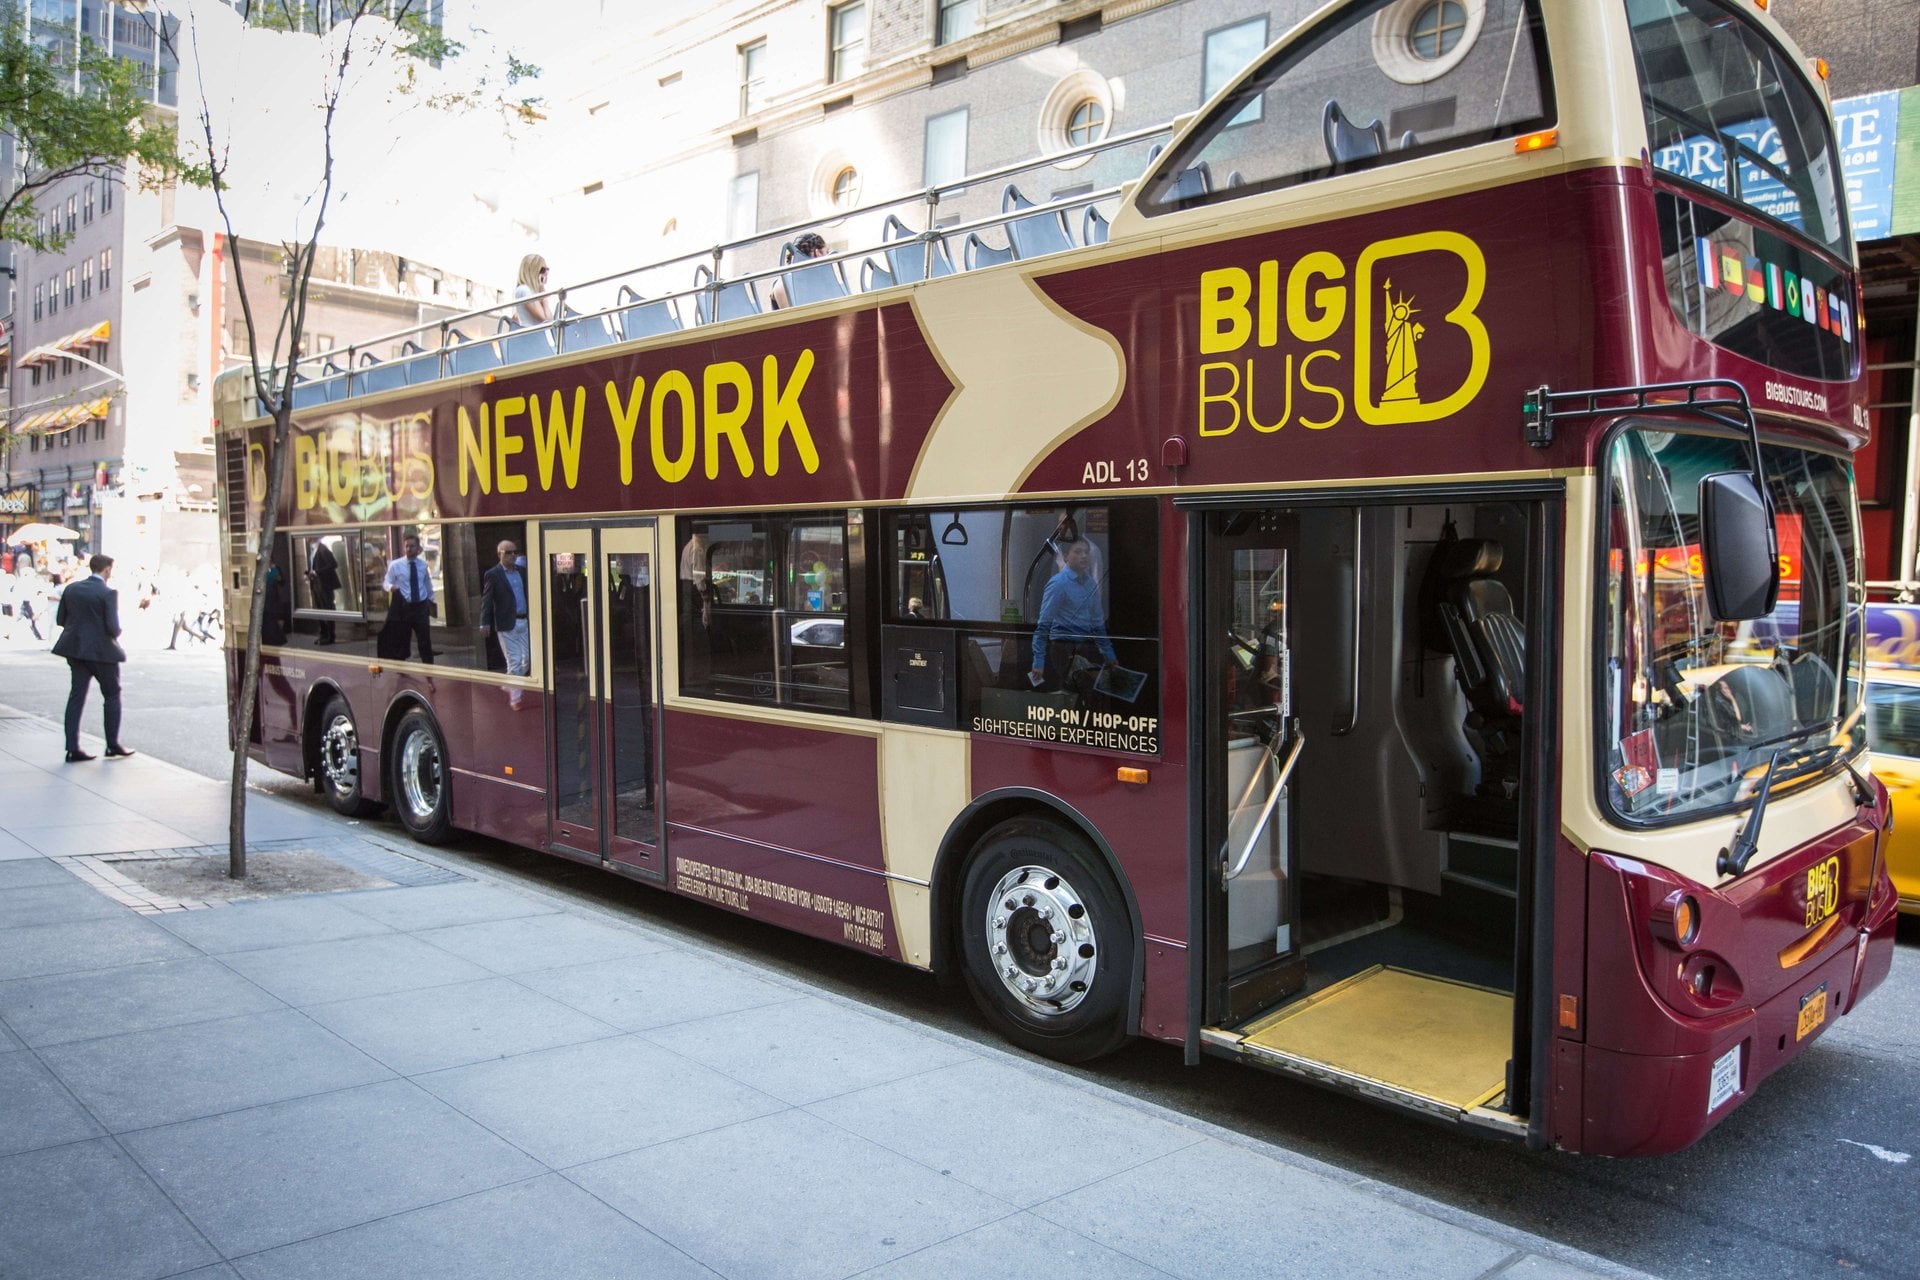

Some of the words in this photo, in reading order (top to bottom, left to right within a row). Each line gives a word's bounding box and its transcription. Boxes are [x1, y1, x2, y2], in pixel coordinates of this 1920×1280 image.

[1200, 251, 1347, 355] BIG
[1199, 349, 1346, 438] BUS
[1765, 381, 1827, 413] BIGBUSTOURS.COM
[457, 385, 587, 497] NEW
[605, 348, 820, 486] YORK
[1853, 403, 1863, 428] ADL
[1863, 408, 1869, 431] 13
[1082, 461, 1121, 484] ADL
[1126, 458, 1149, 482] 13
[973, 716, 1056, 741] SIGHTSEEING
[1059, 727, 1158, 753] EXPERIENCES
[1027, 705, 1080, 726] HOP-ON
[1093, 712, 1158, 733] HOP-OFF
[721, 868, 735, 888] TOURS
[754, 877, 762, 895] BIG
[762, 879, 772, 898] BUS
[772, 882, 787, 902] TOURS
[787, 886, 798, 905] NEW
[798, 888, 811, 909] YORK
[1807, 862, 1826, 900] BIG
[1806, 894, 1824, 929] BUS
[844, 922, 854, 941] NYS
[854, 925, 865, 944] DOT
